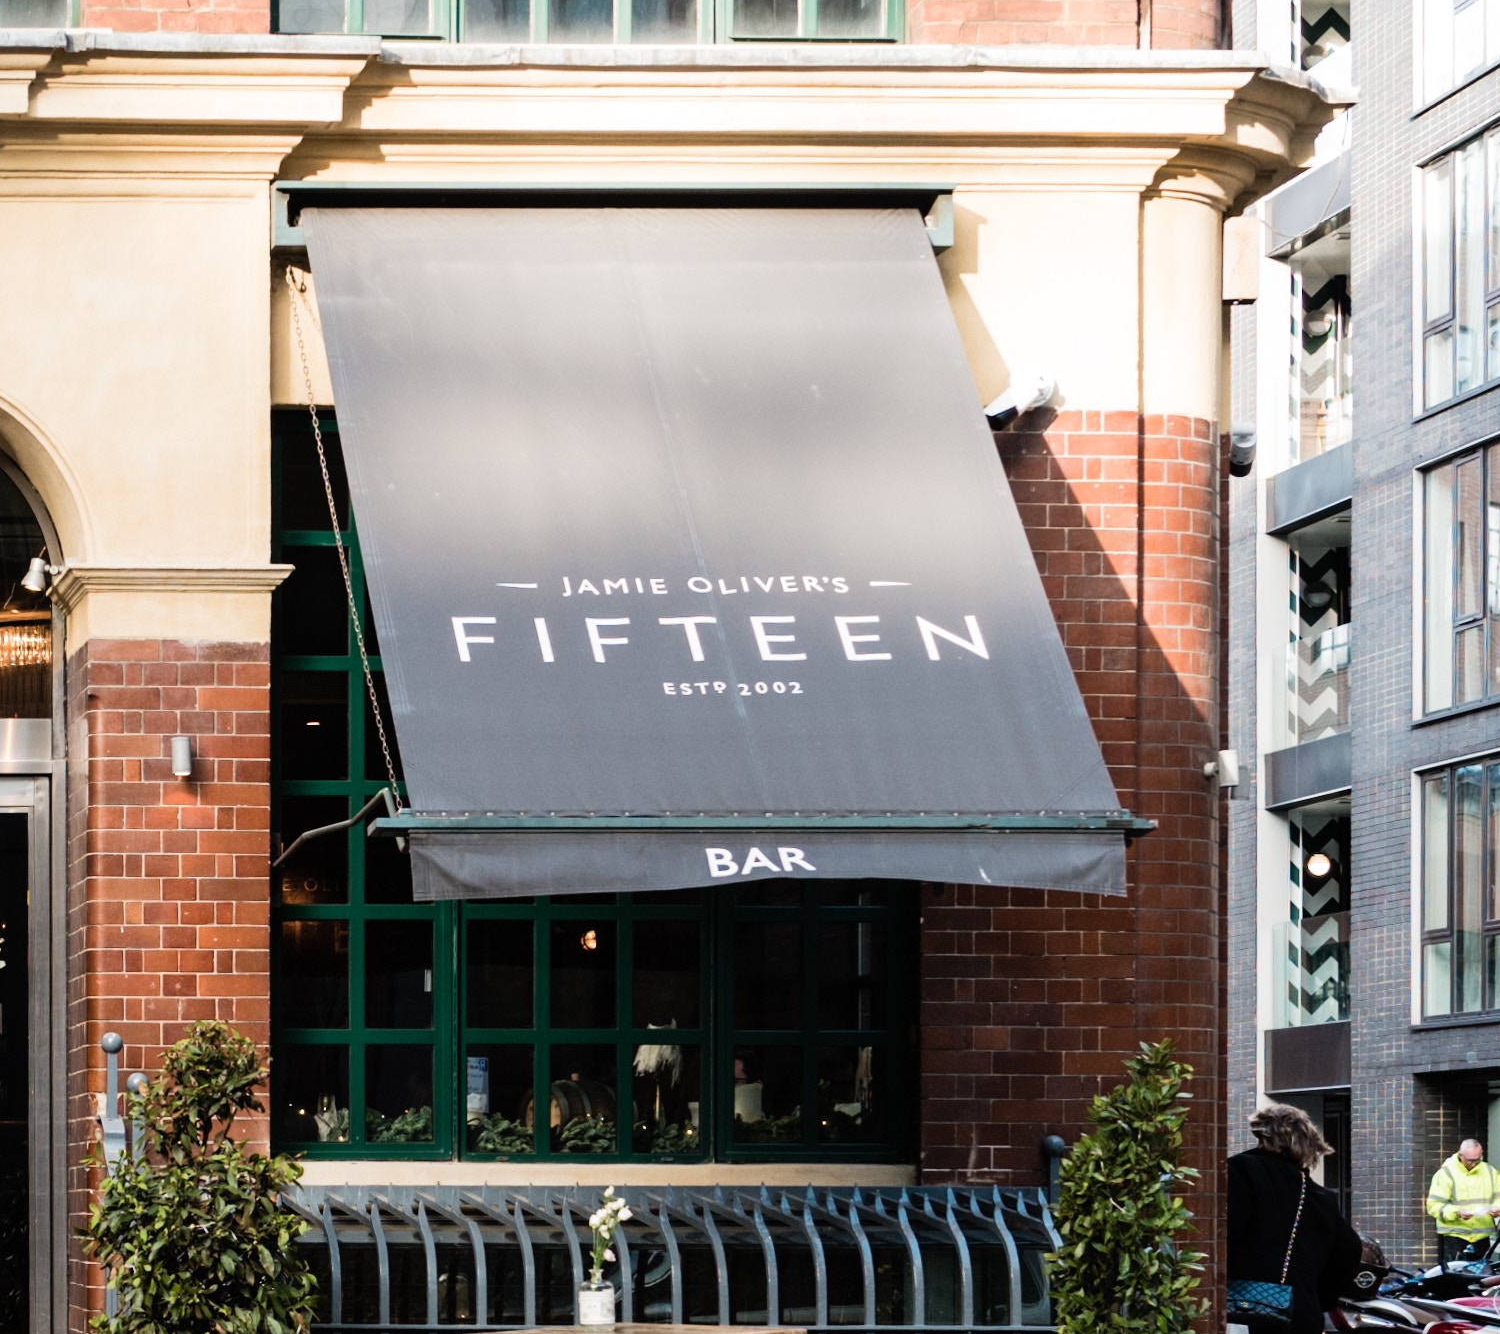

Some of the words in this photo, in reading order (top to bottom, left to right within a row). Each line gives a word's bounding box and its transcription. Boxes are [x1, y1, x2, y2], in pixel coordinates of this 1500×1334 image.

[562, 575, 669, 597] JAMIE
[688, 575, 850, 596] OLIVER'S
[451, 613, 991, 664] FIFTEEN
[736, 681, 804, 697] 2002
[705, 846, 817, 879] BAR
